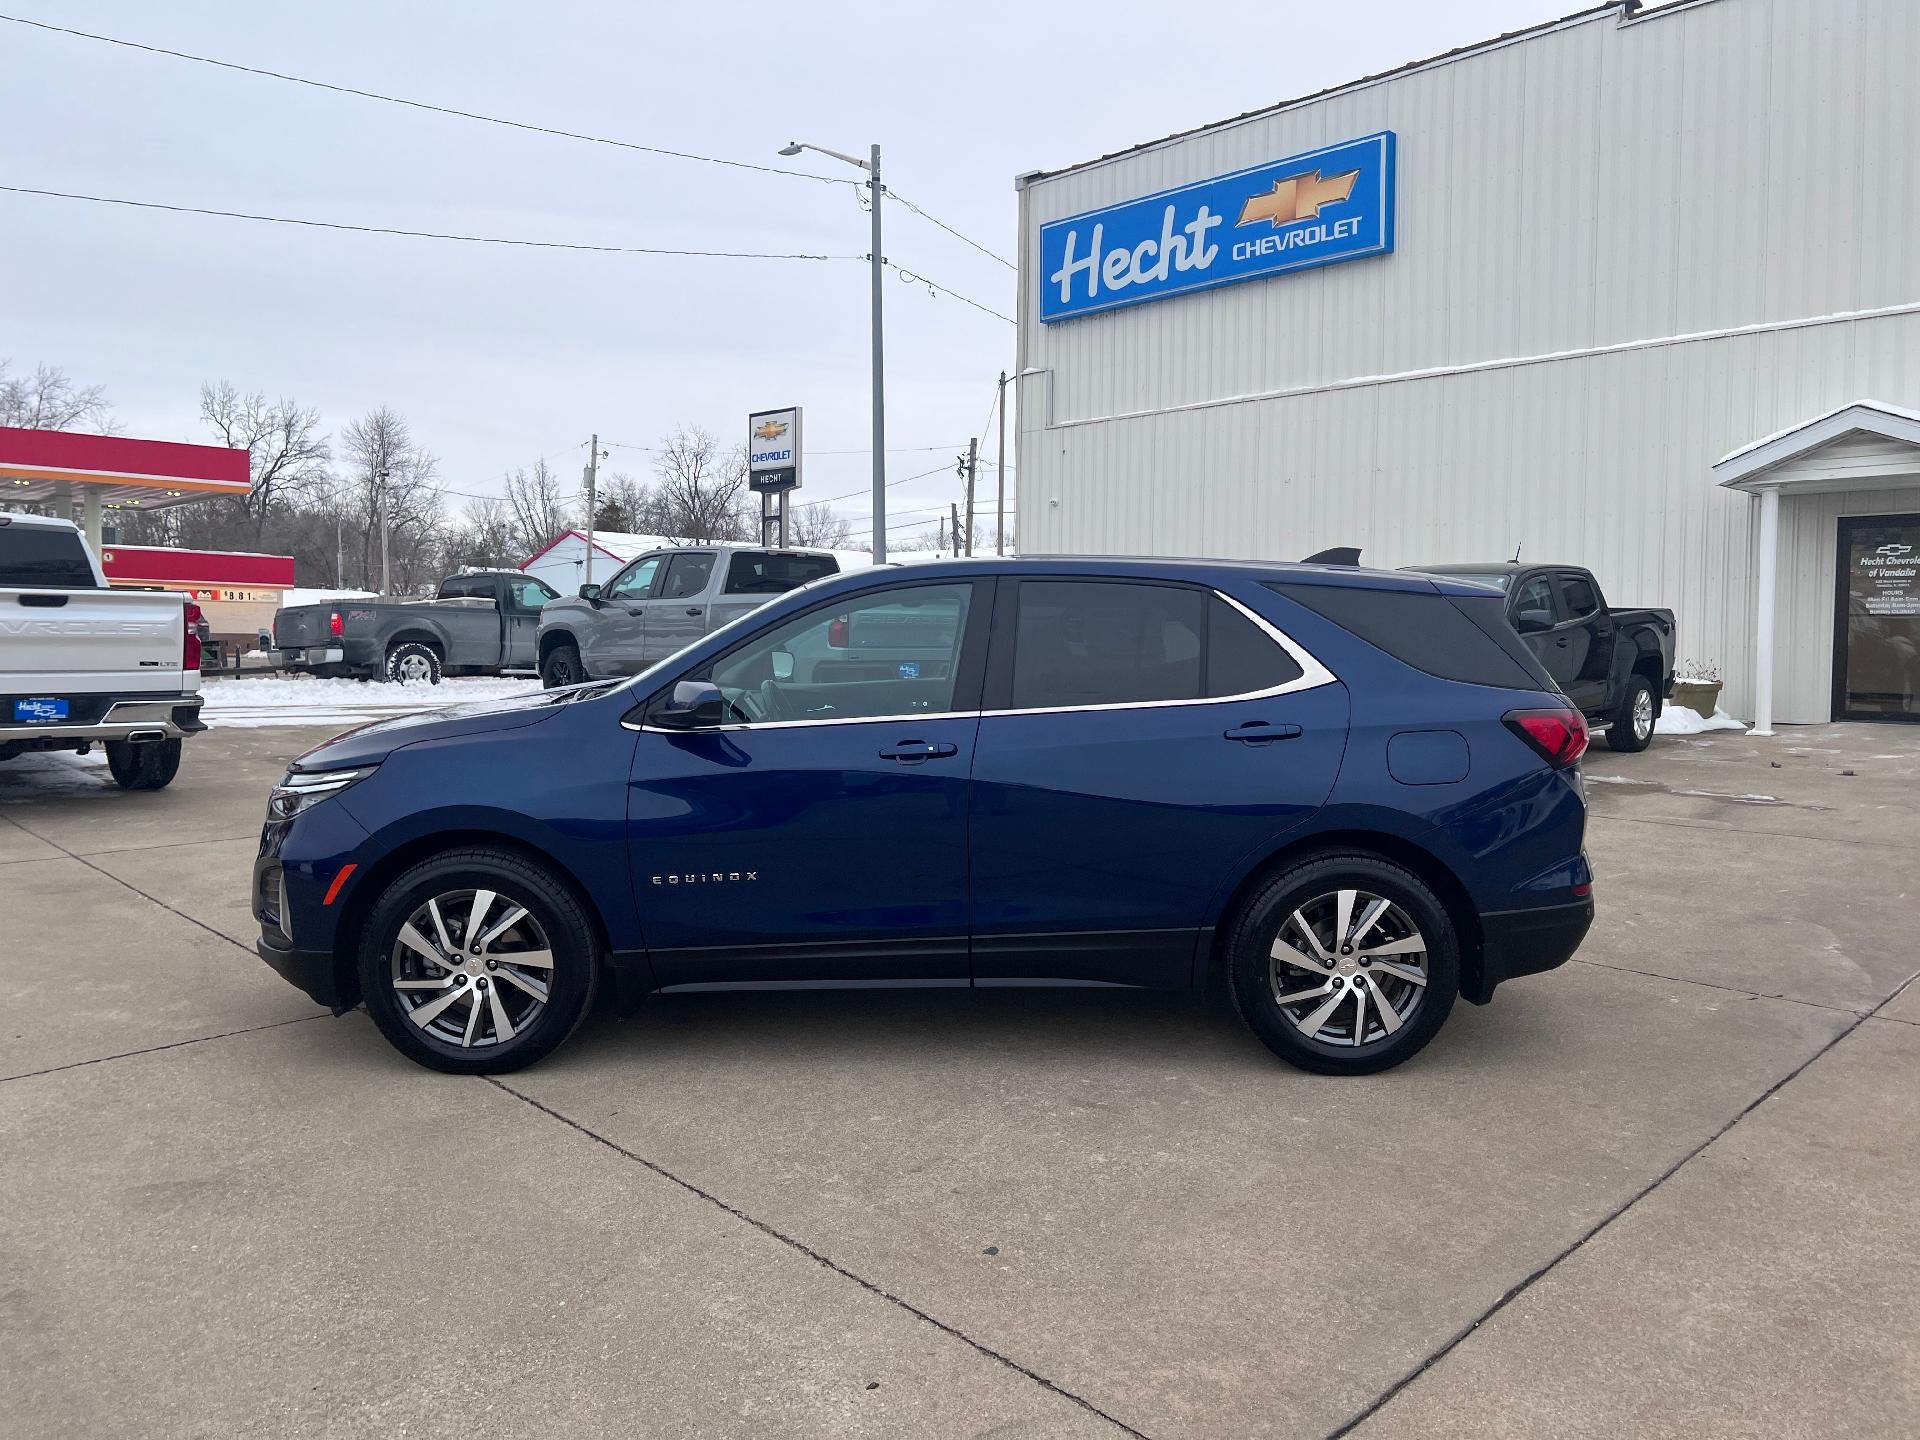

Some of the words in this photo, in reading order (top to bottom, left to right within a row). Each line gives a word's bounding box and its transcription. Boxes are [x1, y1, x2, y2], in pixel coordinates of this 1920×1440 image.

[1232, 216, 1363, 262] CHEVROLET
[1051, 205, 1223, 303] Hecht
[752, 450, 791, 463] CHEVROLET
[760, 474, 782, 484] HECHT
[1860, 557, 1885, 566] Hecht
[1868, 568, 1878, 578] of
[1879, 568, 1917, 577] Vandalia
[652, 871, 757, 885] EQUINOX
